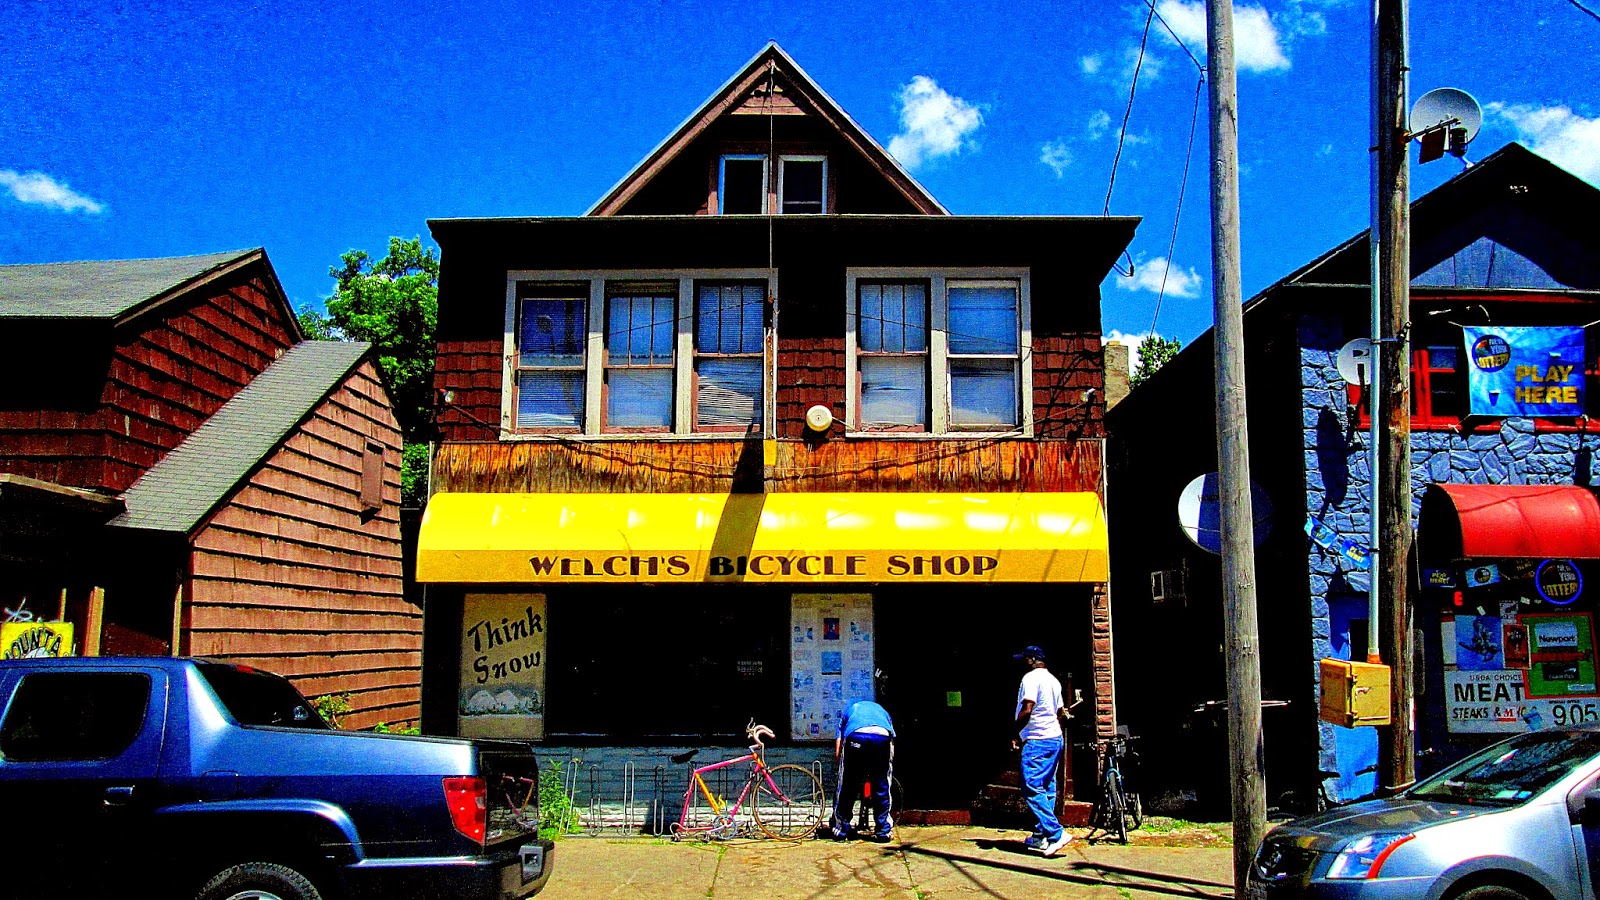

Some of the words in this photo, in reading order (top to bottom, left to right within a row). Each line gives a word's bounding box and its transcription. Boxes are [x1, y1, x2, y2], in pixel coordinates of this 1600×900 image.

[1515, 365, 1573, 382] PLAY
[1514, 386, 1578, 403] HERE
[529, 555, 690, 576] WELCH'S
[709, 555, 867, 576] BICYCLE
[887, 555, 998, 576] SHOP
[467, 606, 543, 652] Think
[1538, 635, 1576, 643] Newport
[473, 651, 541, 684] Snow
[1453, 683, 1524, 702] MEAT
[1452, 707, 1488, 719] STEAKS
